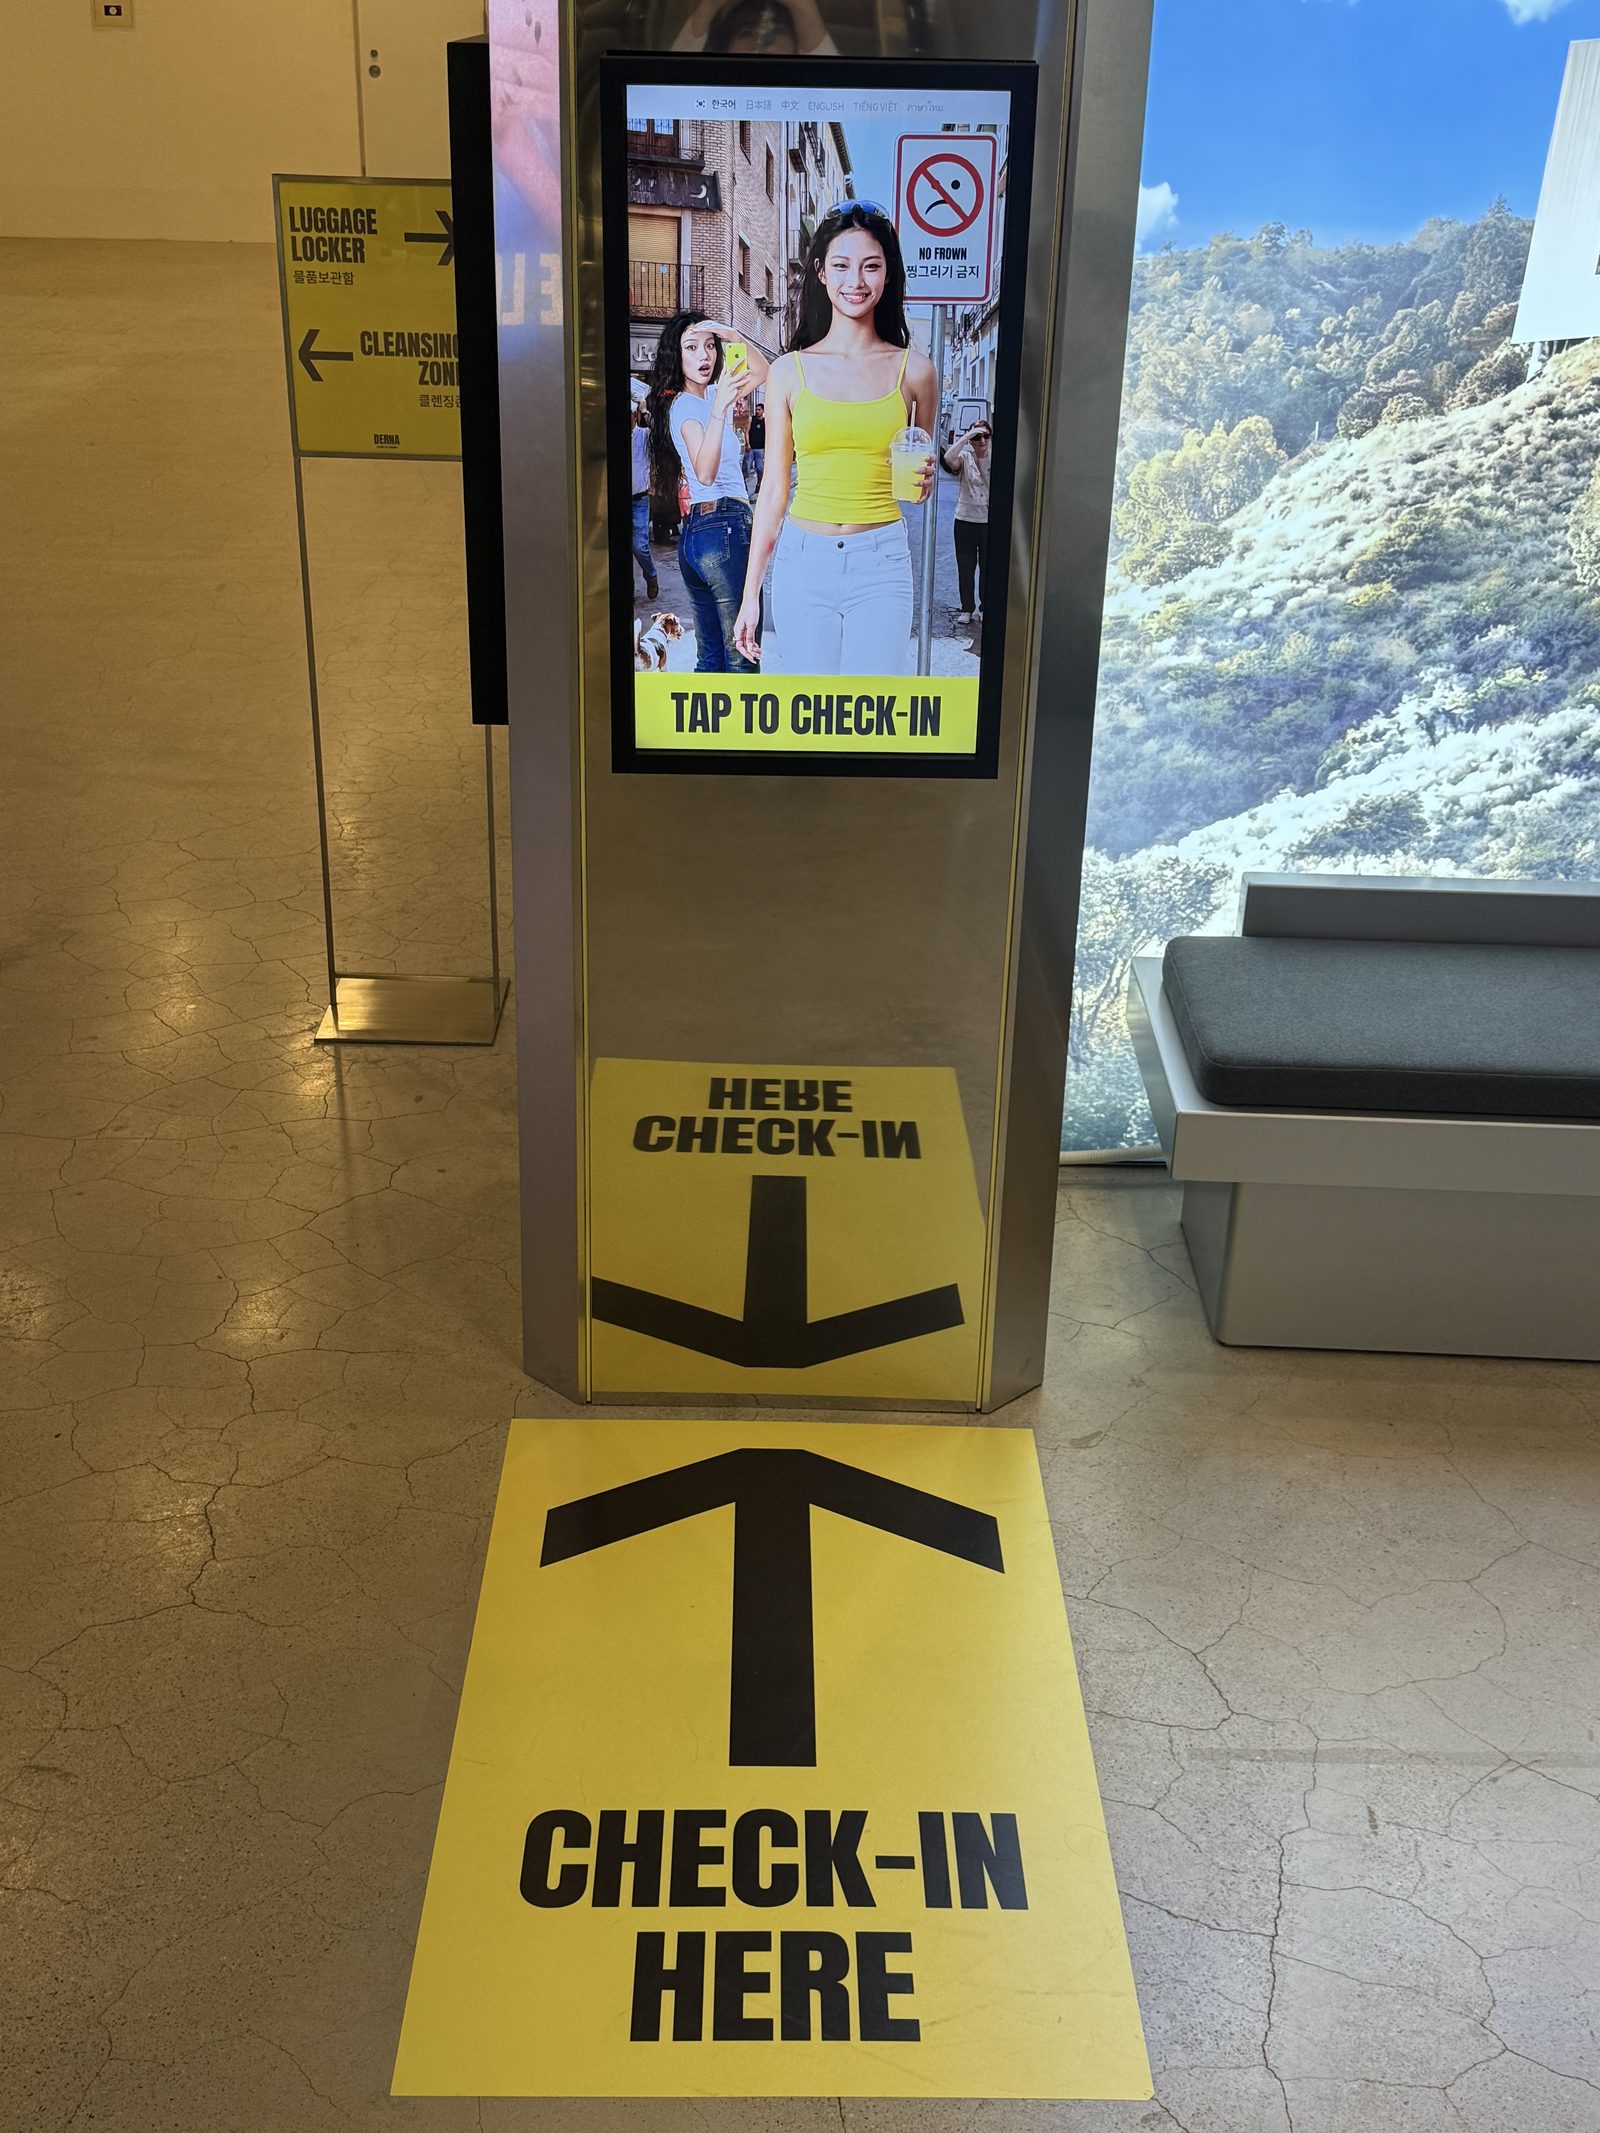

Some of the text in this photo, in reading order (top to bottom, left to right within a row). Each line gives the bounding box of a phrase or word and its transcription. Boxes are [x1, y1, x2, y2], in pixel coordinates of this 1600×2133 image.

[711, 99, 736, 110] 한국어
[746, 99, 772, 111] 日本語
[781, 100, 799, 111] 中文
[808, 101, 845, 111] ENGLISH
[854, 100, 898, 113] TIẾNG VIỆT
[289, 206, 378, 235] LUGGAGE
[290, 236, 366, 264] LOCKER
[919, 247, 967, 261] NO FROWN
[293, 270, 354, 286] 물품보관함
[906, 264, 979, 279] 찡그리기 금지
[670, 692, 942, 737] TAP TO CHECK-IN
[519, 1808, 1029, 1910] CHECK-IN
[629, 1931, 921, 2042] HERE
